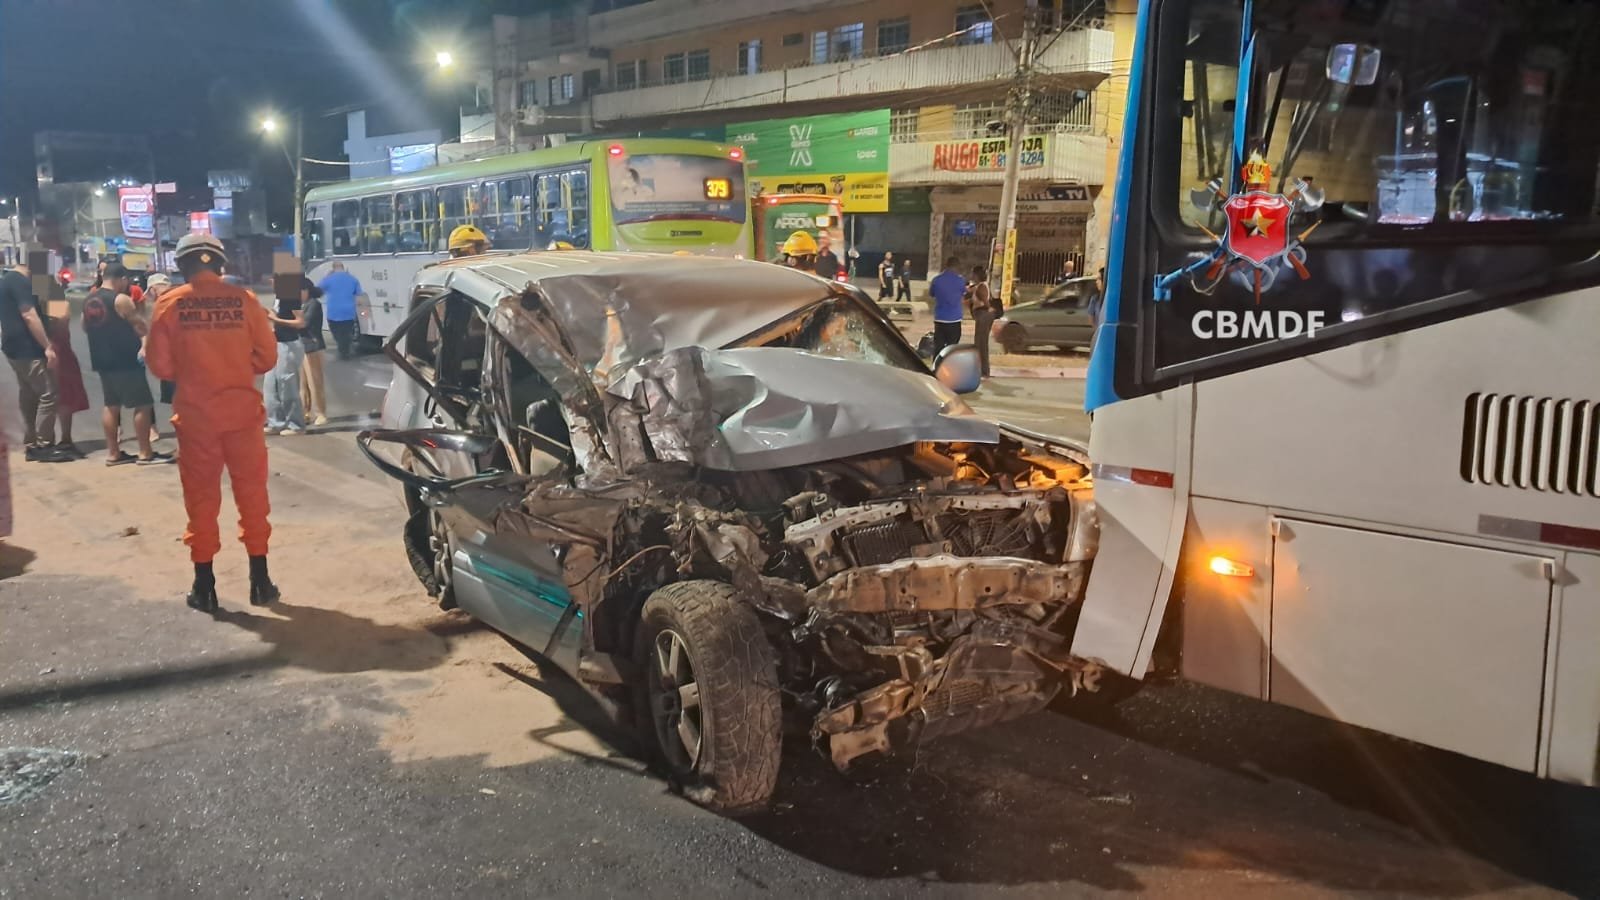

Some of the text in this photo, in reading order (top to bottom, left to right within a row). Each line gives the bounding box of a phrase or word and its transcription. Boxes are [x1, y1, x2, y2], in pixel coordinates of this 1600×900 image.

[933, 143, 979, 169] ALUGO
[982, 141, 1006, 154] ESTA
[705, 179, 729, 198] 379
[1066, 189, 1084, 200] TV
[177, 297, 243, 309] BOMBEIRO
[179, 309, 244, 322] MILITAR
